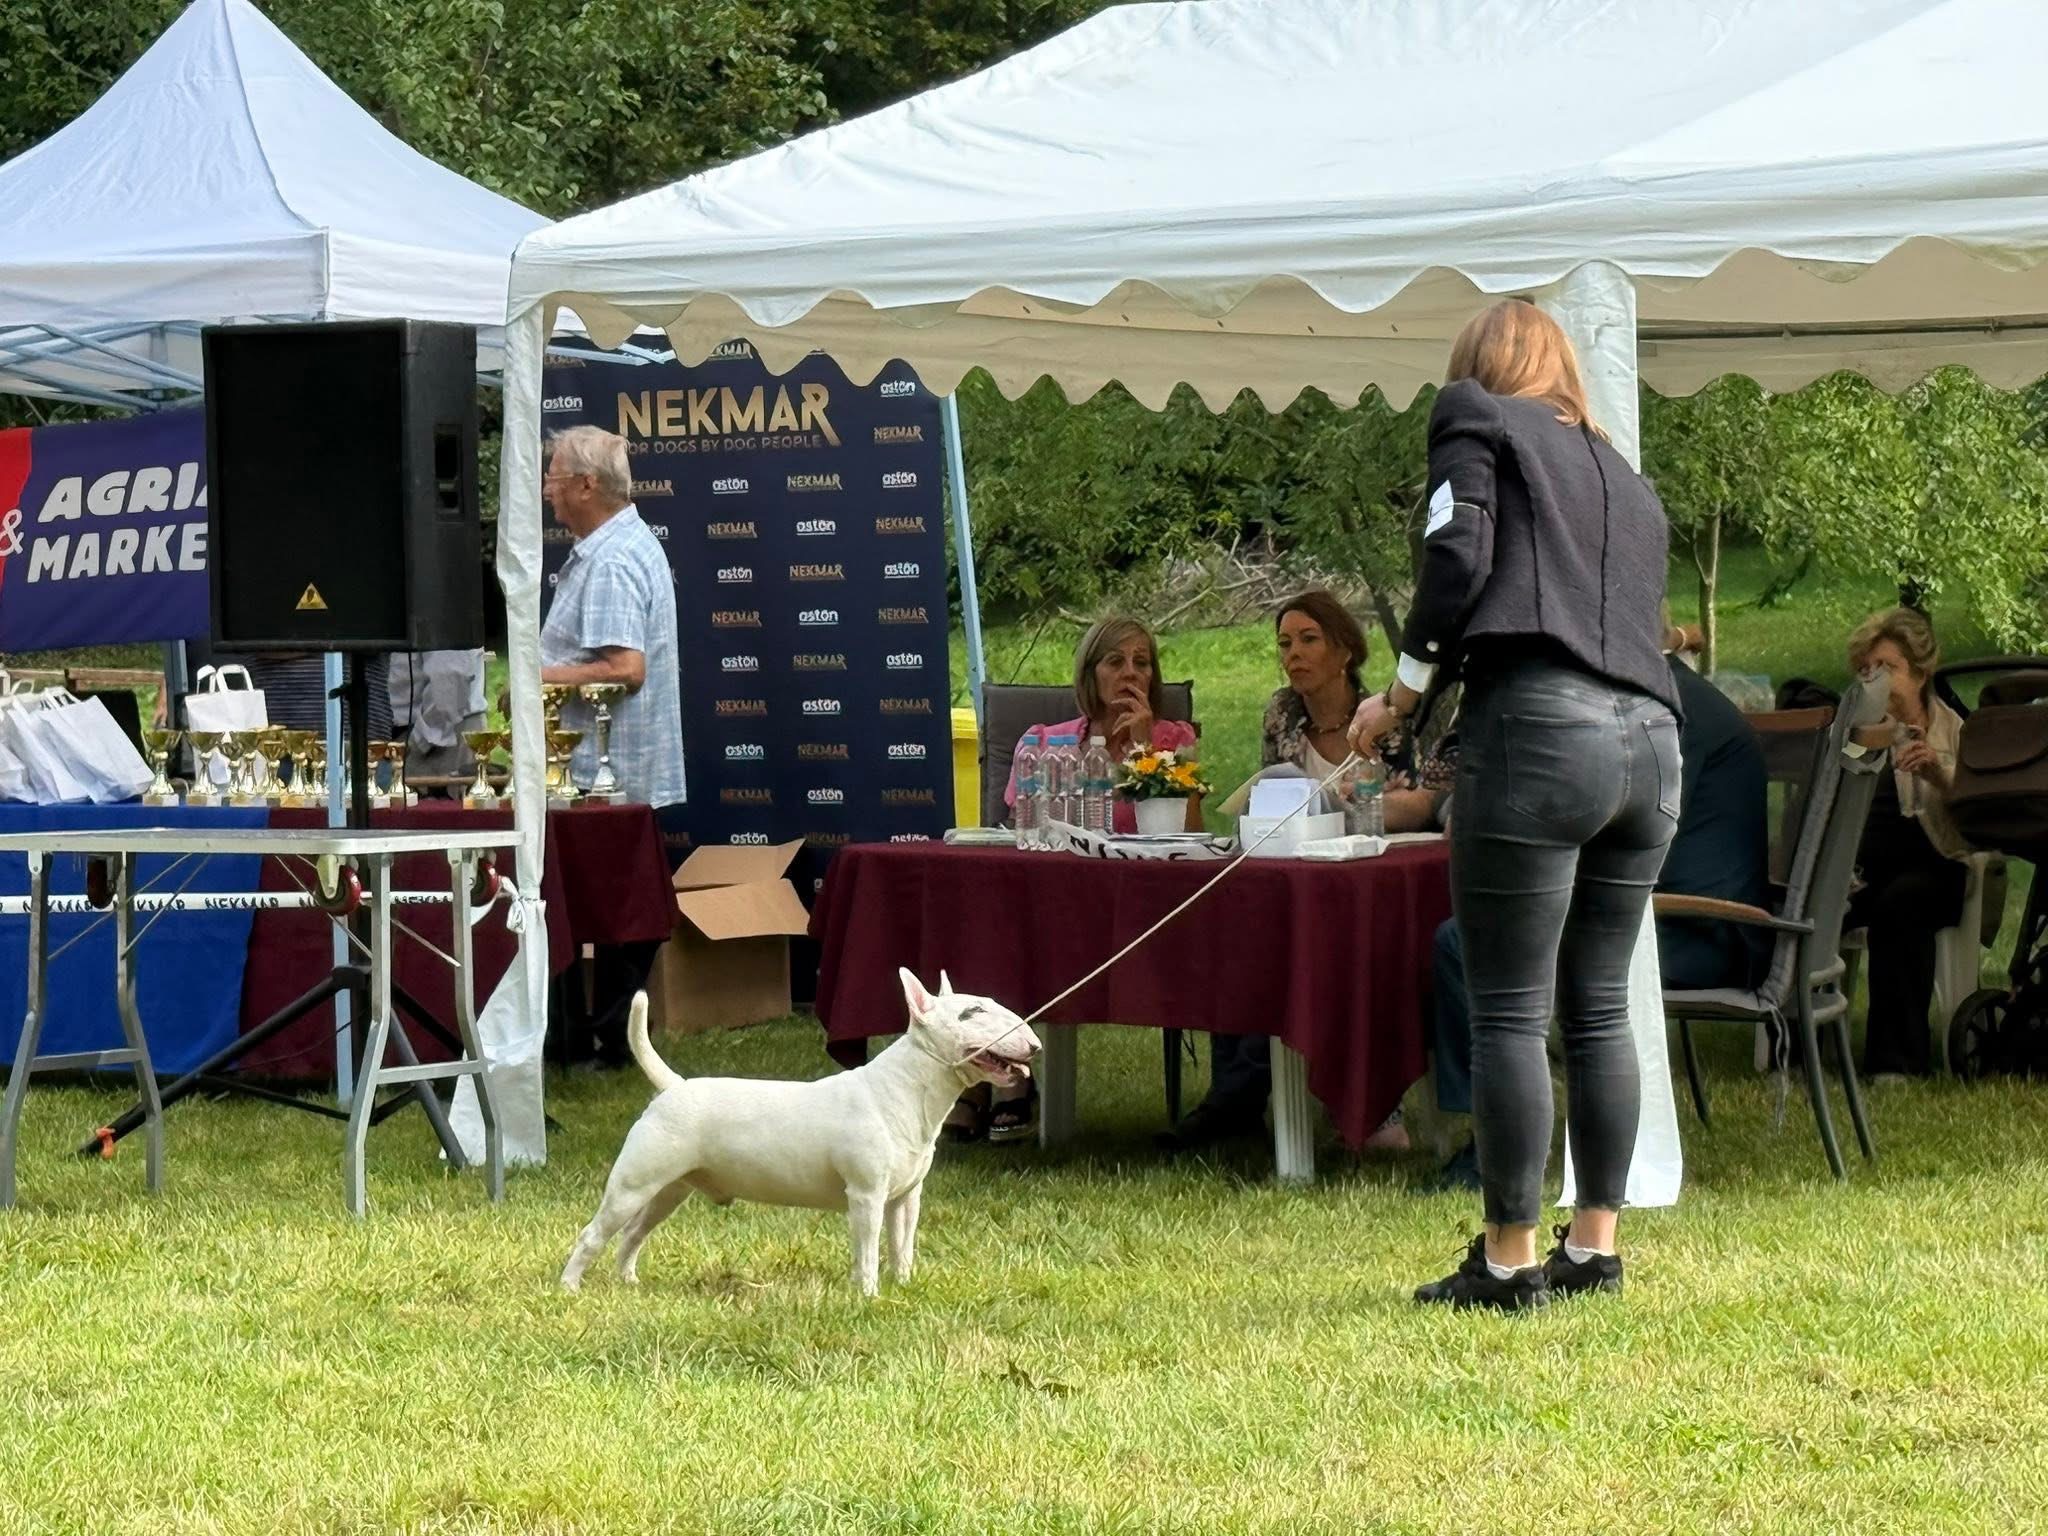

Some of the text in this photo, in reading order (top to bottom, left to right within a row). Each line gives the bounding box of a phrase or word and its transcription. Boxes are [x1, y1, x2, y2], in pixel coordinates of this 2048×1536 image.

[617, 383, 841, 447] NEKMAR
[873, 425, 924, 442] NEKMAR
[654, 440, 697, 454] DOGS
[701, 439, 719, 451] BY
[724, 438, 757, 451] DOG
[761, 435, 822, 450] PEOPLE
[631, 480, 674, 496] EKMAR
